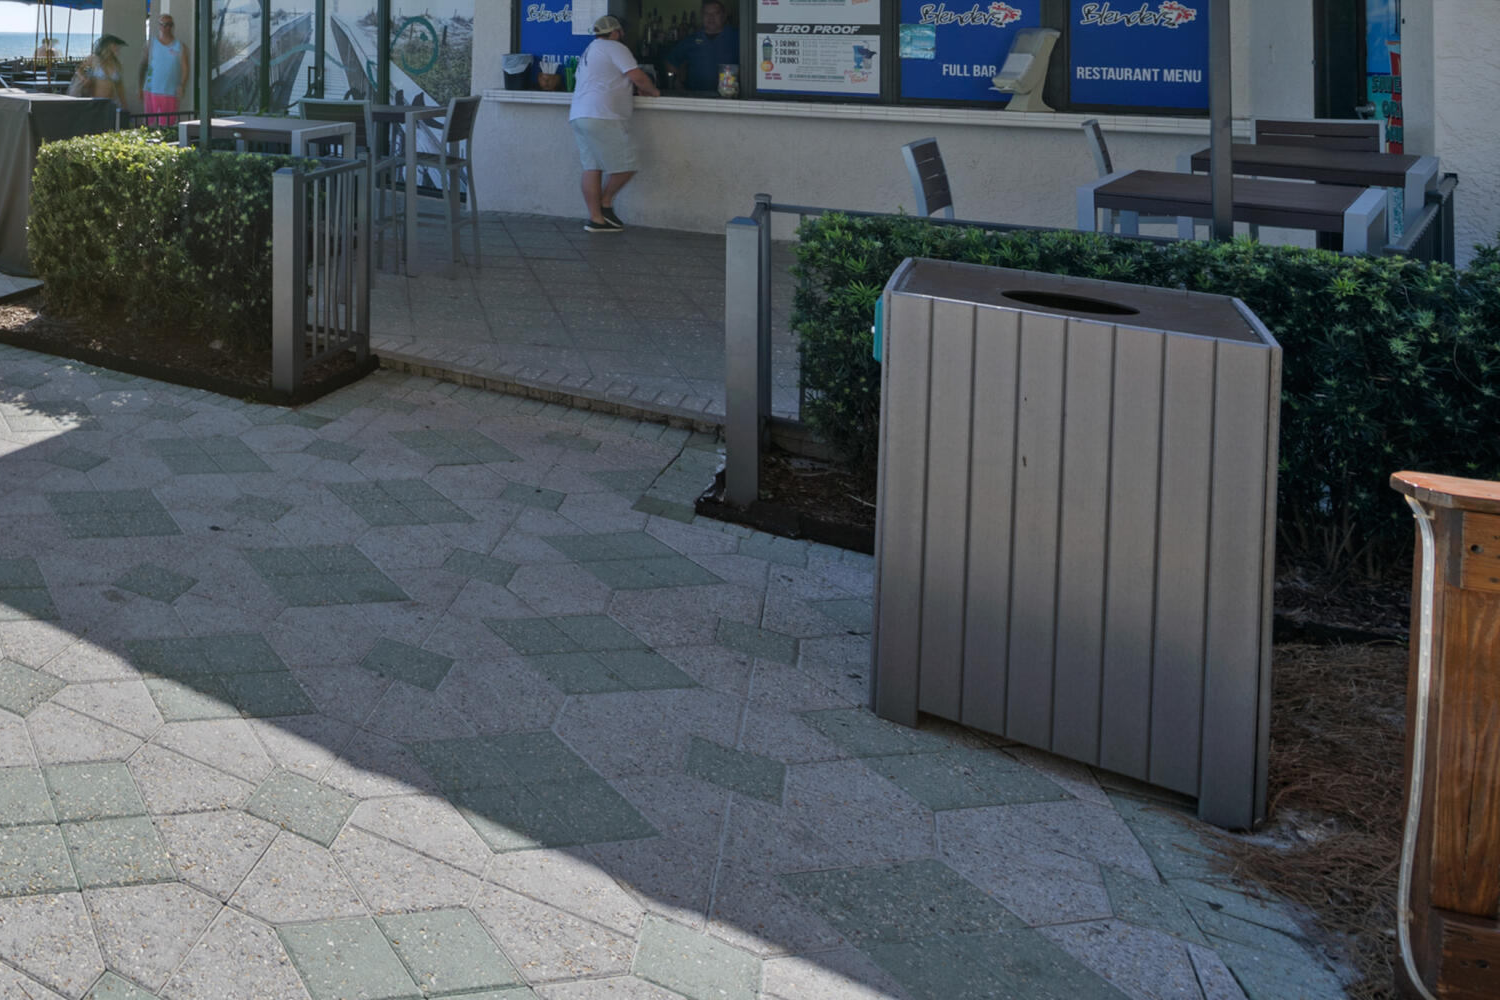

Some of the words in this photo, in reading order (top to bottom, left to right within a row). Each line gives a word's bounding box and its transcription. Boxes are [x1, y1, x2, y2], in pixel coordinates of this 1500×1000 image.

[526, 3, 572, 23] Blend
[919, 3, 1004, 28] Blenders
[1080, 2, 1179, 28] Blenders
[775, 24, 810, 34] ZERO
[813, 25, 860, 34] PROOF
[779, 48, 800, 56] DRINKS
[942, 63, 970, 77] FULL
[973, 64, 997, 78] BAR
[1076, 66, 1160, 82] RESTAURANT
[1163, 68, 1202, 83] MENU
